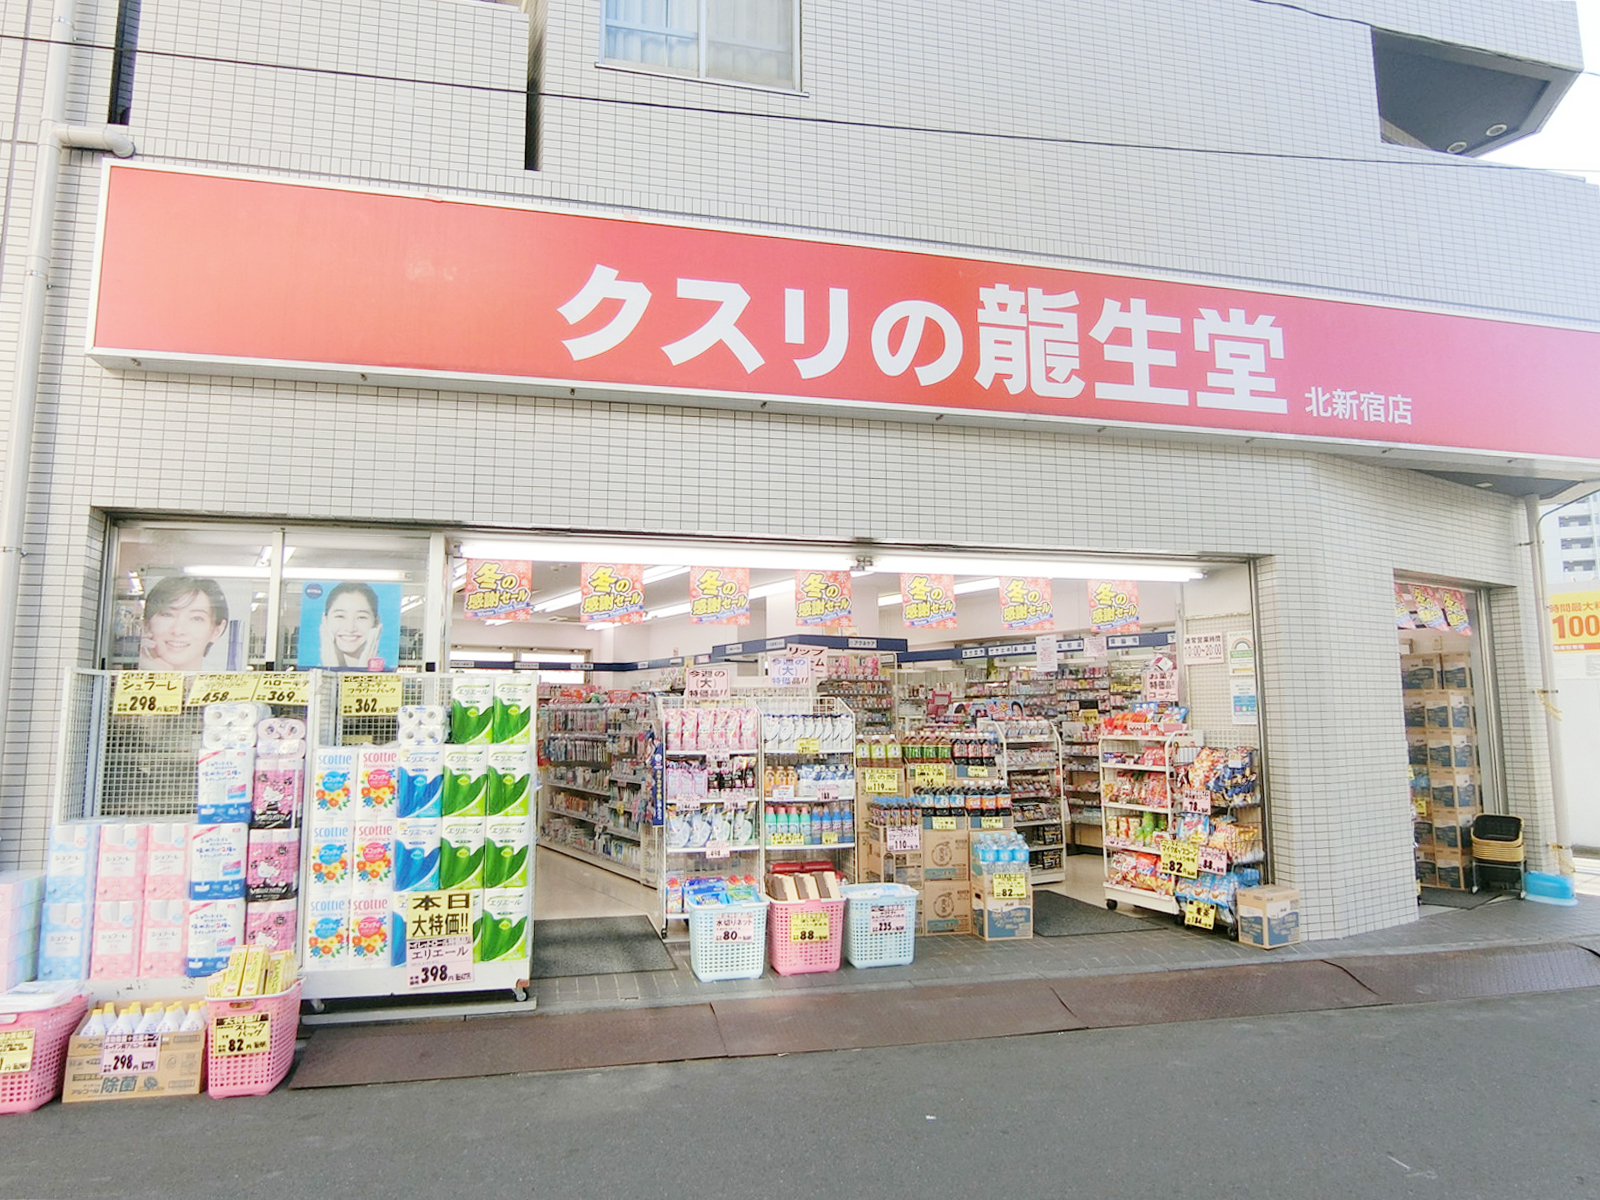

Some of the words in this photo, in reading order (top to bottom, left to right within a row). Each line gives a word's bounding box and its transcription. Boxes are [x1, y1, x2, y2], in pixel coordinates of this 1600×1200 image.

[557, 264, 1288, 415] クスリの龍生堂
[1304, 386, 1413, 426] 北新宿店
[473, 562, 517, 589] 冬の
[589, 566, 631, 593] 冬の
[698, 570, 736, 596] 冬の
[801, 573, 839, 599] 冬の
[908, 576, 943, 602] 冬の
[1005, 579, 1041, 603] 冬の
[1094, 582, 1128, 607] 冬の
[466, 589, 528, 611] 感謝セール
[582, 590, 643, 614] 感謝セール
[691, 593, 747, 617] 感謝セール
[797, 597, 850, 617] 感謝セール
[903, 599, 954, 619] 感謝セール
[1001, 601, 1051, 623] 感謝セール
[1091, 605, 1138, 624] 感謝セール
[771, 658, 806, 666] 今週の
[122, 680, 178, 692] シュフーレ
[129, 695, 157, 711] 298
[201, 691, 229, 703] 458
[267, 691, 296, 702] 369
[355, 698, 378, 713] 362
[1188, 801, 1198, 811] 78
[895, 840, 907, 849] 110
[1168, 860, 1183, 873] 82
[1001, 888, 1013, 897] 82
[412, 893, 470, 911] 本日
[412, 913, 469, 937] 大特価!!
[878, 921, 892, 931] 235
[723, 930, 738, 940] 80
[799, 930, 814, 940] 88
[411, 946, 469, 960] エリエール
[421, 964, 448, 984] 398
[228, 1038, 244, 1052] 82
[112, 1054, 133, 1071] 298
[101, 1076, 139, 1094] 除菌
